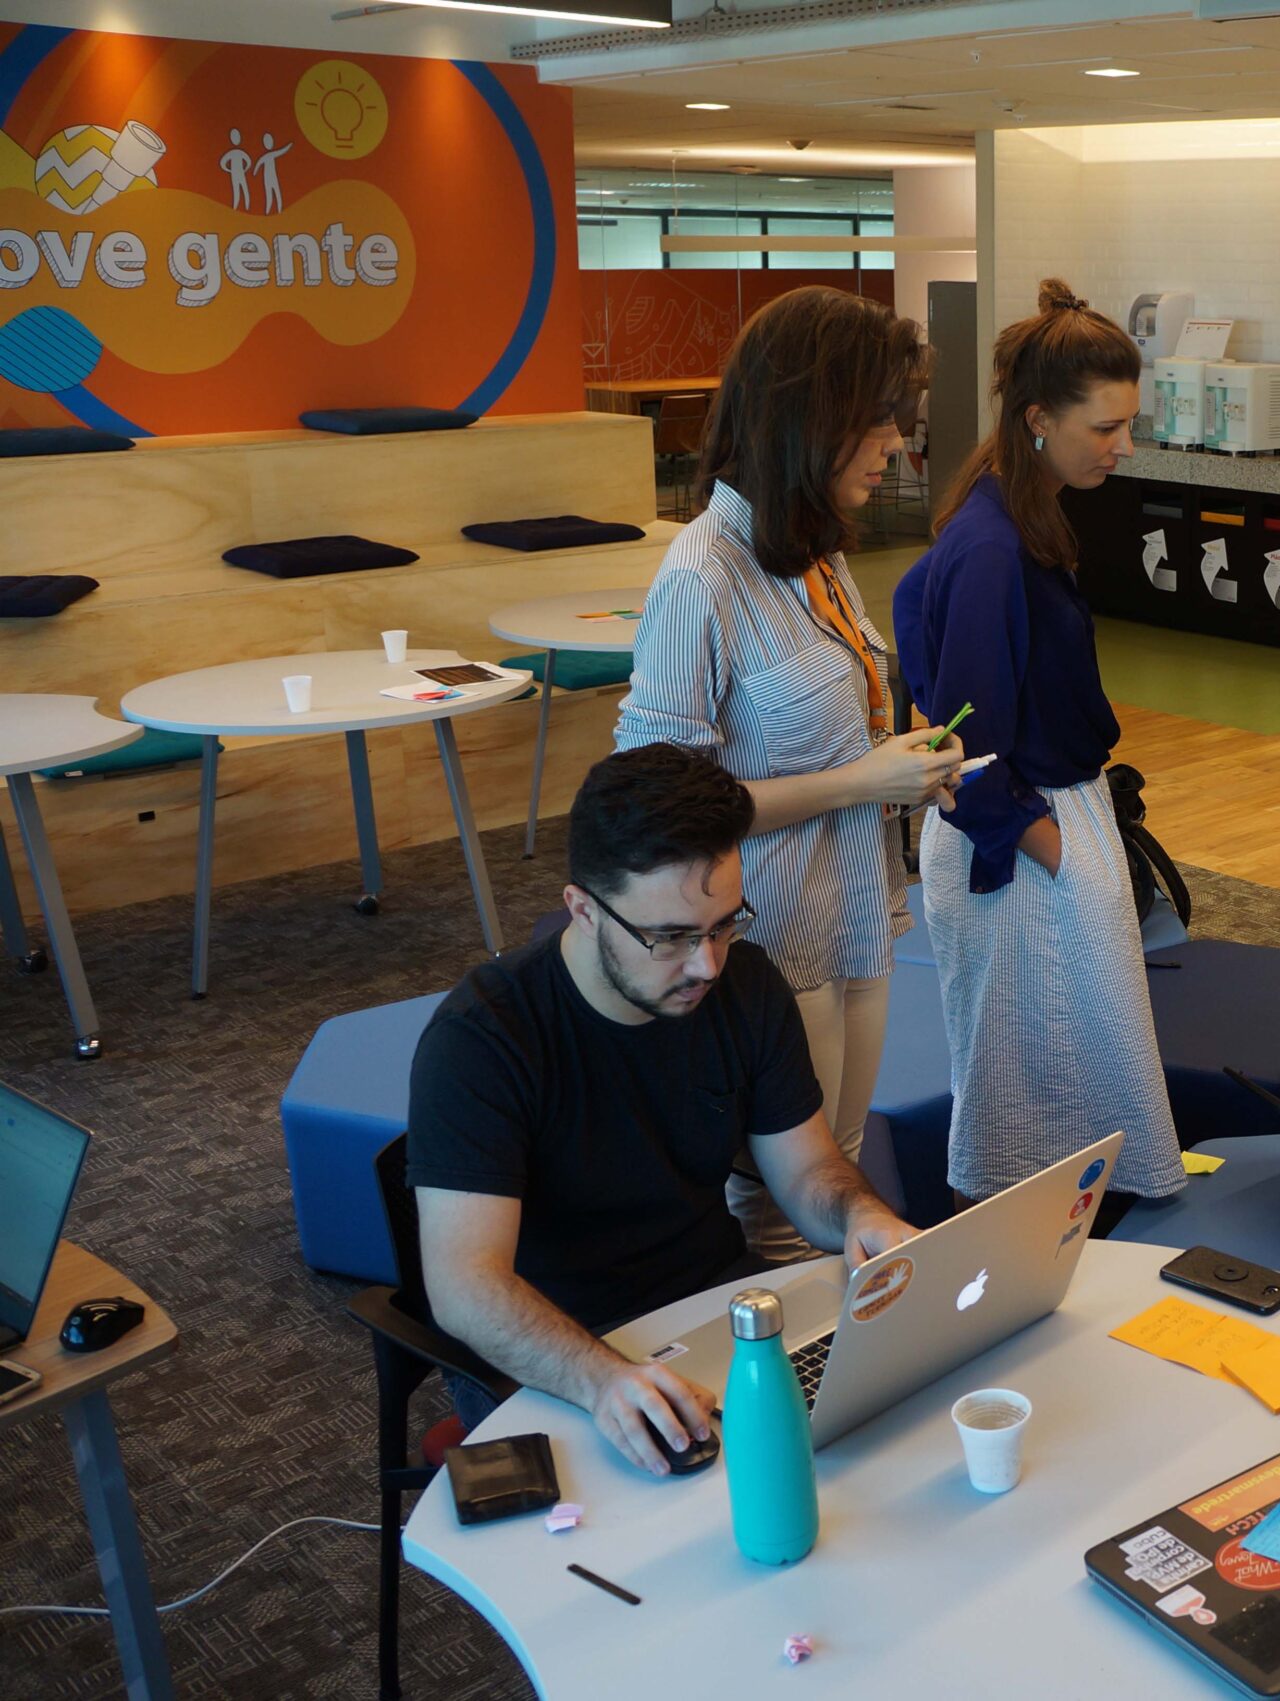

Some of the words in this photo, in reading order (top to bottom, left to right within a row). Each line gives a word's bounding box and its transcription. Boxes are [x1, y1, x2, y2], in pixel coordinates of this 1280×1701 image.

[168, 221, 398, 307] gente
[1134, 1530, 1166, 1548] cubo
[1177, 1551, 1195, 1565] de
